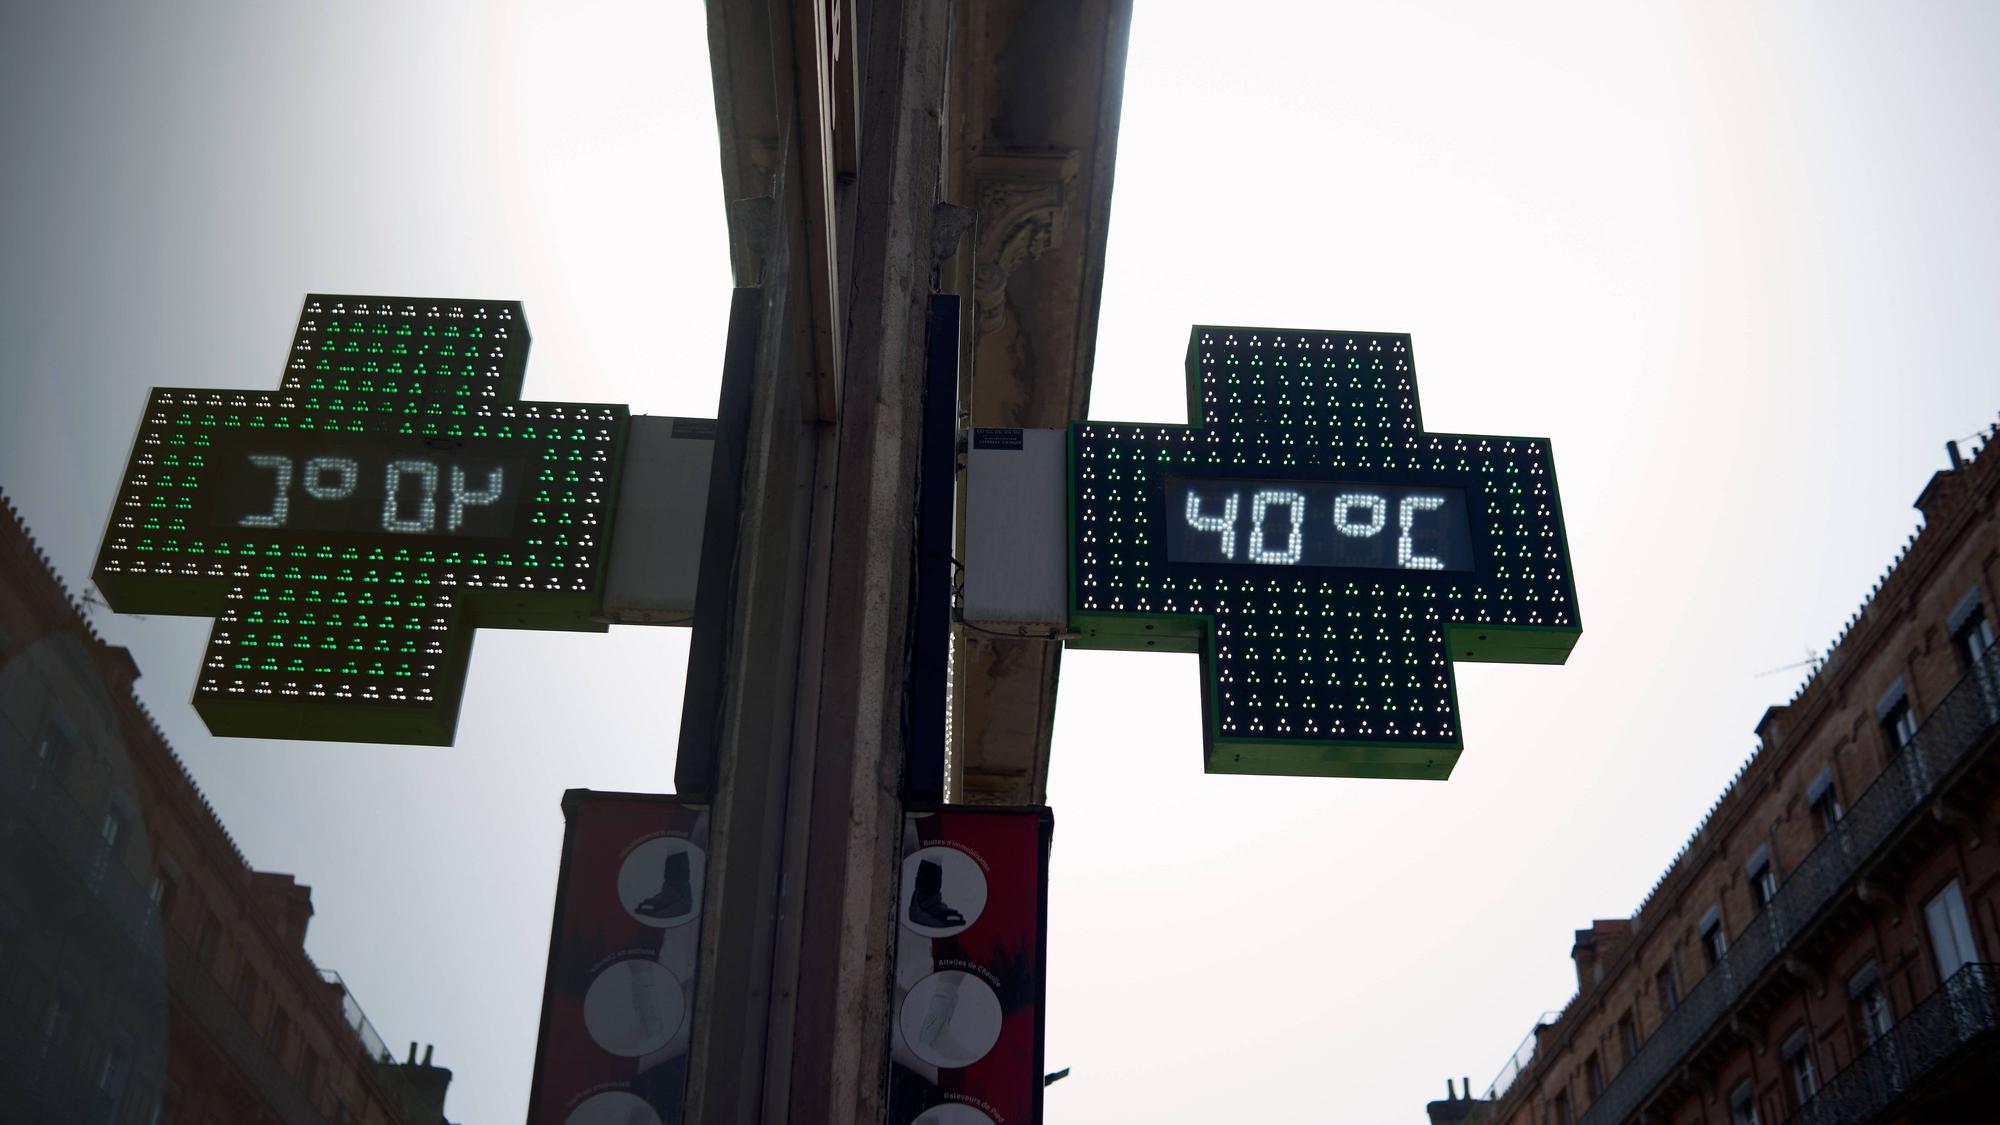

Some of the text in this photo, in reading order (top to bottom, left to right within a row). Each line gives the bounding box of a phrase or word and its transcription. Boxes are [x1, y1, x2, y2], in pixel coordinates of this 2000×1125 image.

[1185, 491, 1306, 566] 40
[938, 959, 1001, 988] Attelles de Cheville
[943, 1091, 982, 1105] Releveurs
[981, 1101, 991, 1111] de
